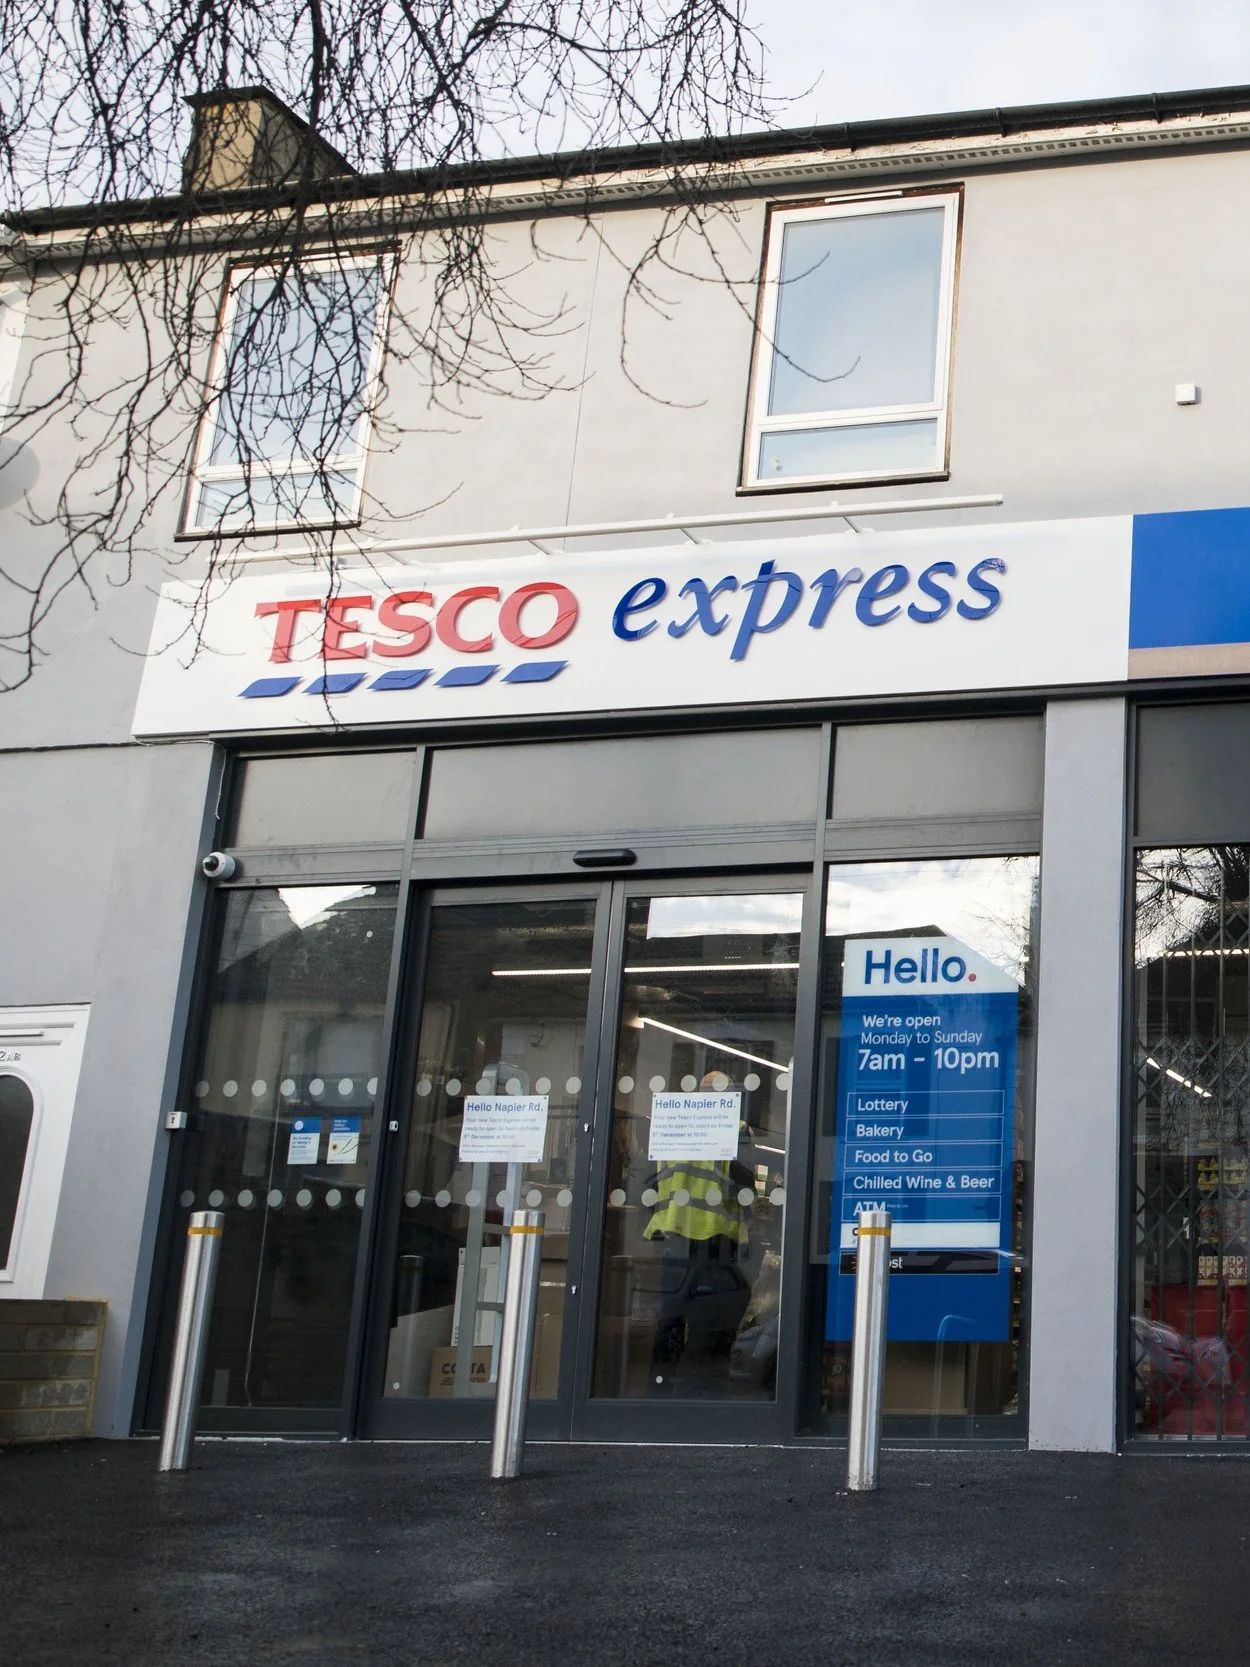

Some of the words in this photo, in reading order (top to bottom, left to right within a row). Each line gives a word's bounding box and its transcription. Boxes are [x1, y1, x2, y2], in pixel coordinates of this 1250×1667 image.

[253, 582, 582, 664] TESCO
[612, 558, 1006, 661] express
[864, 947, 977, 984] Hello.
[862, 1014, 902, 1028] We're
[905, 1015, 941, 1029] open
[860, 1032, 913, 1047] Monday
[916, 1032, 931, 1044] to
[934, 1030, 983, 1046] Sunday
[858, 1049, 906, 1071] 7am
[934, 1047, 1000, 1075] 10pm
[466, 1102, 493, 1112] Hello
[494, 1102, 527, 1114] Napier
[528, 1101, 544, 1112] Rd.
[654, 1099, 681, 1109] Hello
[683, 1098, 717, 1111] Napier
[719, 1098, 737, 1109] Rd.
[857, 1098, 909, 1114] Lottery
[856, 1123, 905, 1140] Bakery
[854, 1149, 890, 1163] Food
[893, 1150, 909, 1163] to
[912, 1149, 933, 1163] Go
[853, 1175, 902, 1190] Chilled
[906, 1175, 942, 1189] Wine
[945, 1175, 957, 1189] &
[960, 1174, 995, 1189] Beer
[853, 1200, 887, 1217] ATM
